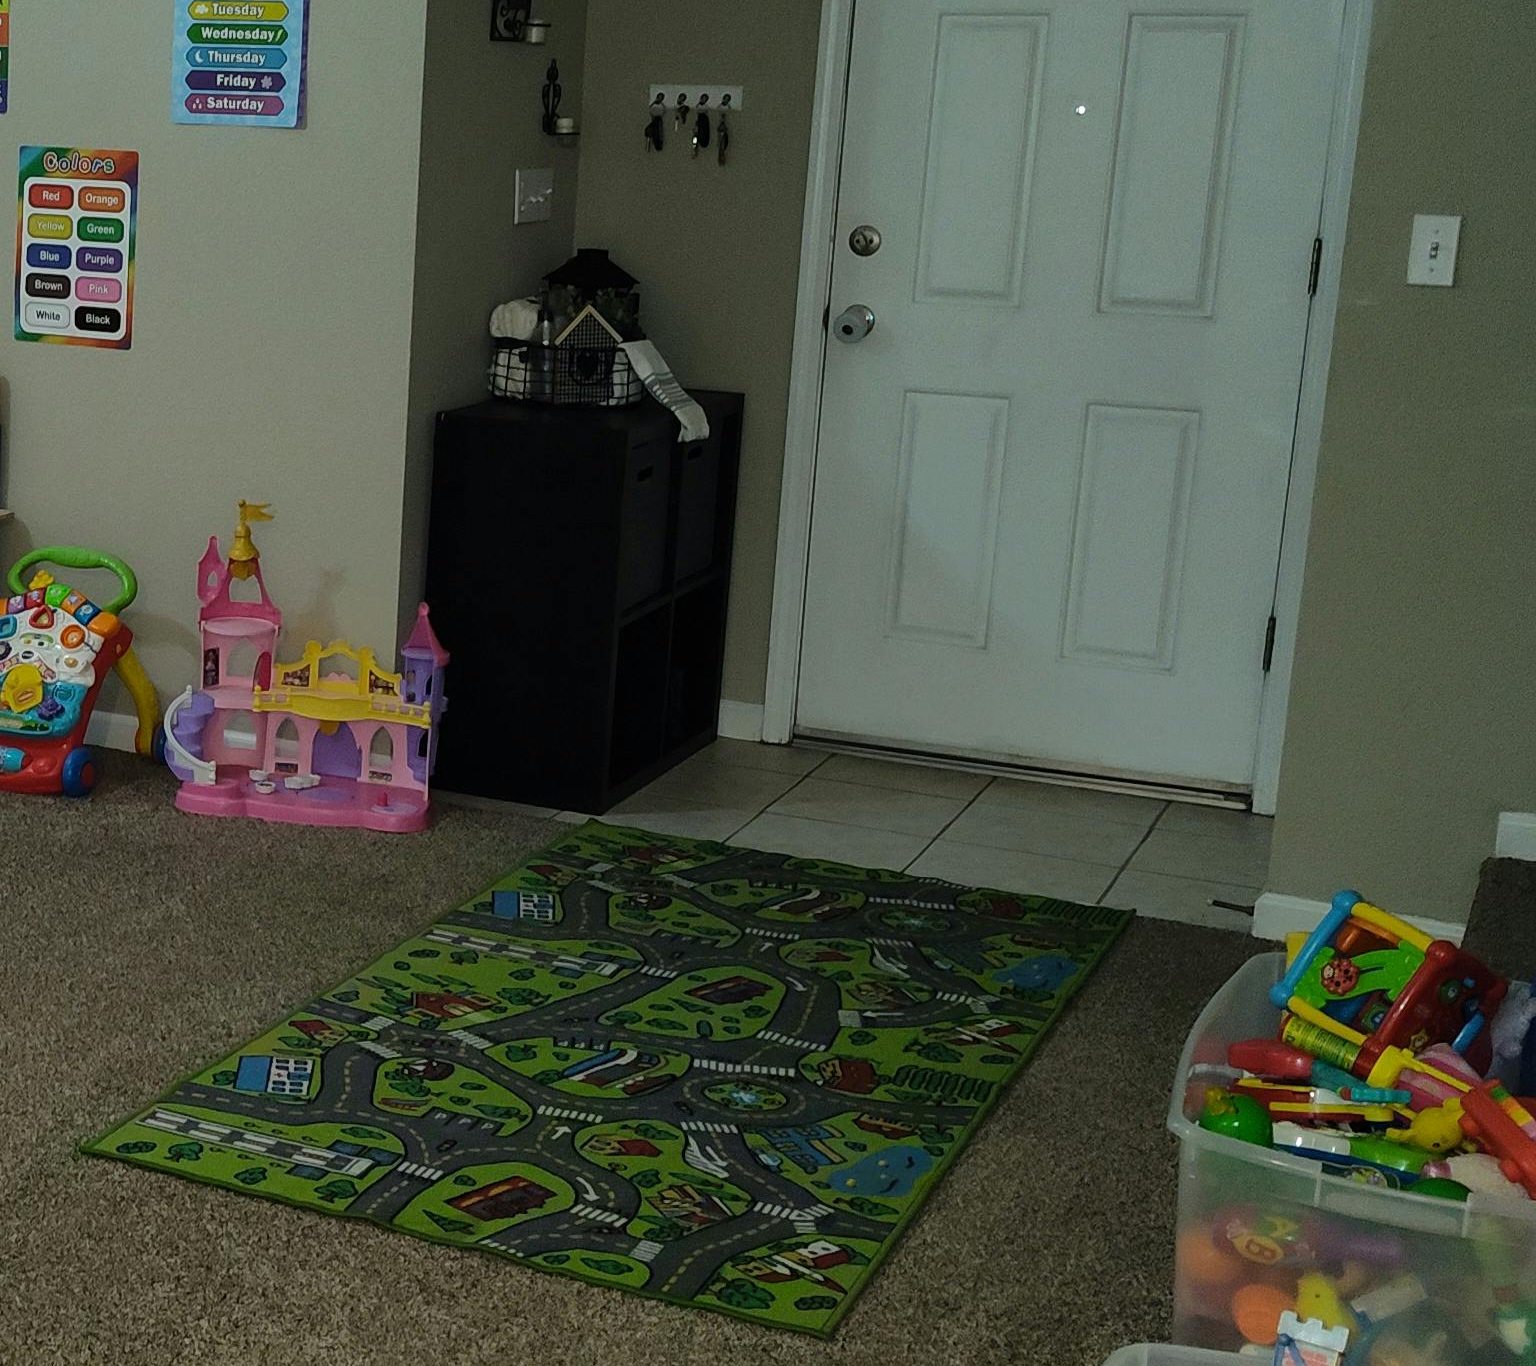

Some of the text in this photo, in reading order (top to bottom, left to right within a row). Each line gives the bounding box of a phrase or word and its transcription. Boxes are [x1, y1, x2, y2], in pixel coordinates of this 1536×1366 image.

[212, 3, 264, 18] Tuesday
[201, 26, 275, 42] Wednesday
[207, 50, 265, 66] Thursday
[216, 74, 256, 89] Friday
[207, 97, 264, 112] Saturday
[44, 151, 115, 174] Colors
[42, 190, 60, 201] Red
[85, 193, 119, 206] Orange
[37, 220, 65, 231] Yellow
[87, 223, 115, 235] Green
[39, 250, 60, 262] Blue
[85, 253, 115, 266] Purple
[34, 279, 63, 291] Brown
[88, 284, 109, 294] Pink
[36, 310, 61, 321] White
[85, 313, 111, 325] Black
